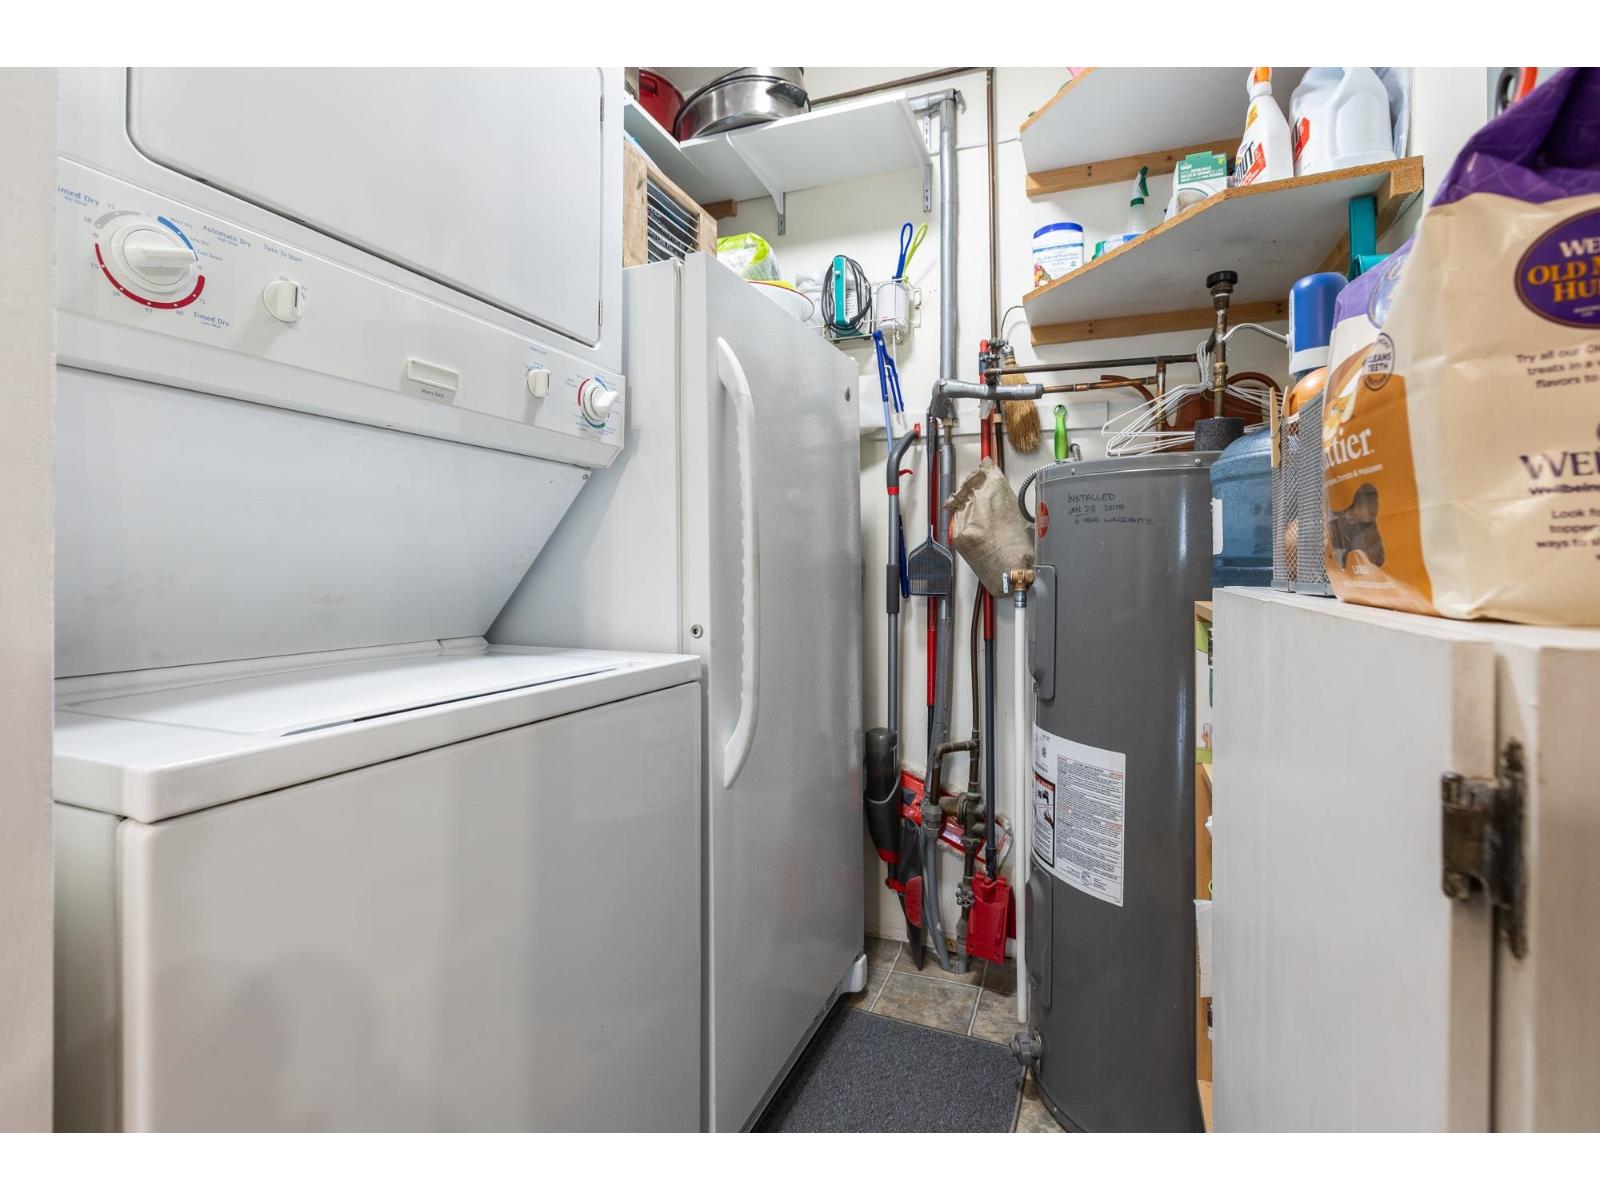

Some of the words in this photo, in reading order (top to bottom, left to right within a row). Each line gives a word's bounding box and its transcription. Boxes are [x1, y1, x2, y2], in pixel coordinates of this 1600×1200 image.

[84, 195, 99, 206] Dry
[202, 224, 238, 243] Automatic
[239, 237, 252, 248] Dry
[264, 243, 279, 255] Turn
[280, 249, 288, 258] To
[288, 253, 302, 263] Start
[1527, 261, 1587, 286] OLD
[217, 317, 230, 328] Dry
[1515, 353, 1537, 363] Try
[1540, 349, 1554, 360] all
[1368, 362, 1388, 372] TEETH
[1527, 364, 1565, 375] treats
[1568, 362, 1582, 370] in
[1536, 376, 1580, 389] flavors
[1584, 374, 1599, 383] to
[1067, 493, 1116, 504] INSTALLED
[1068, 505, 1082, 515] JAN
[1550, 508, 1585, 519] Look
[1536, 540, 1569, 550] ways
